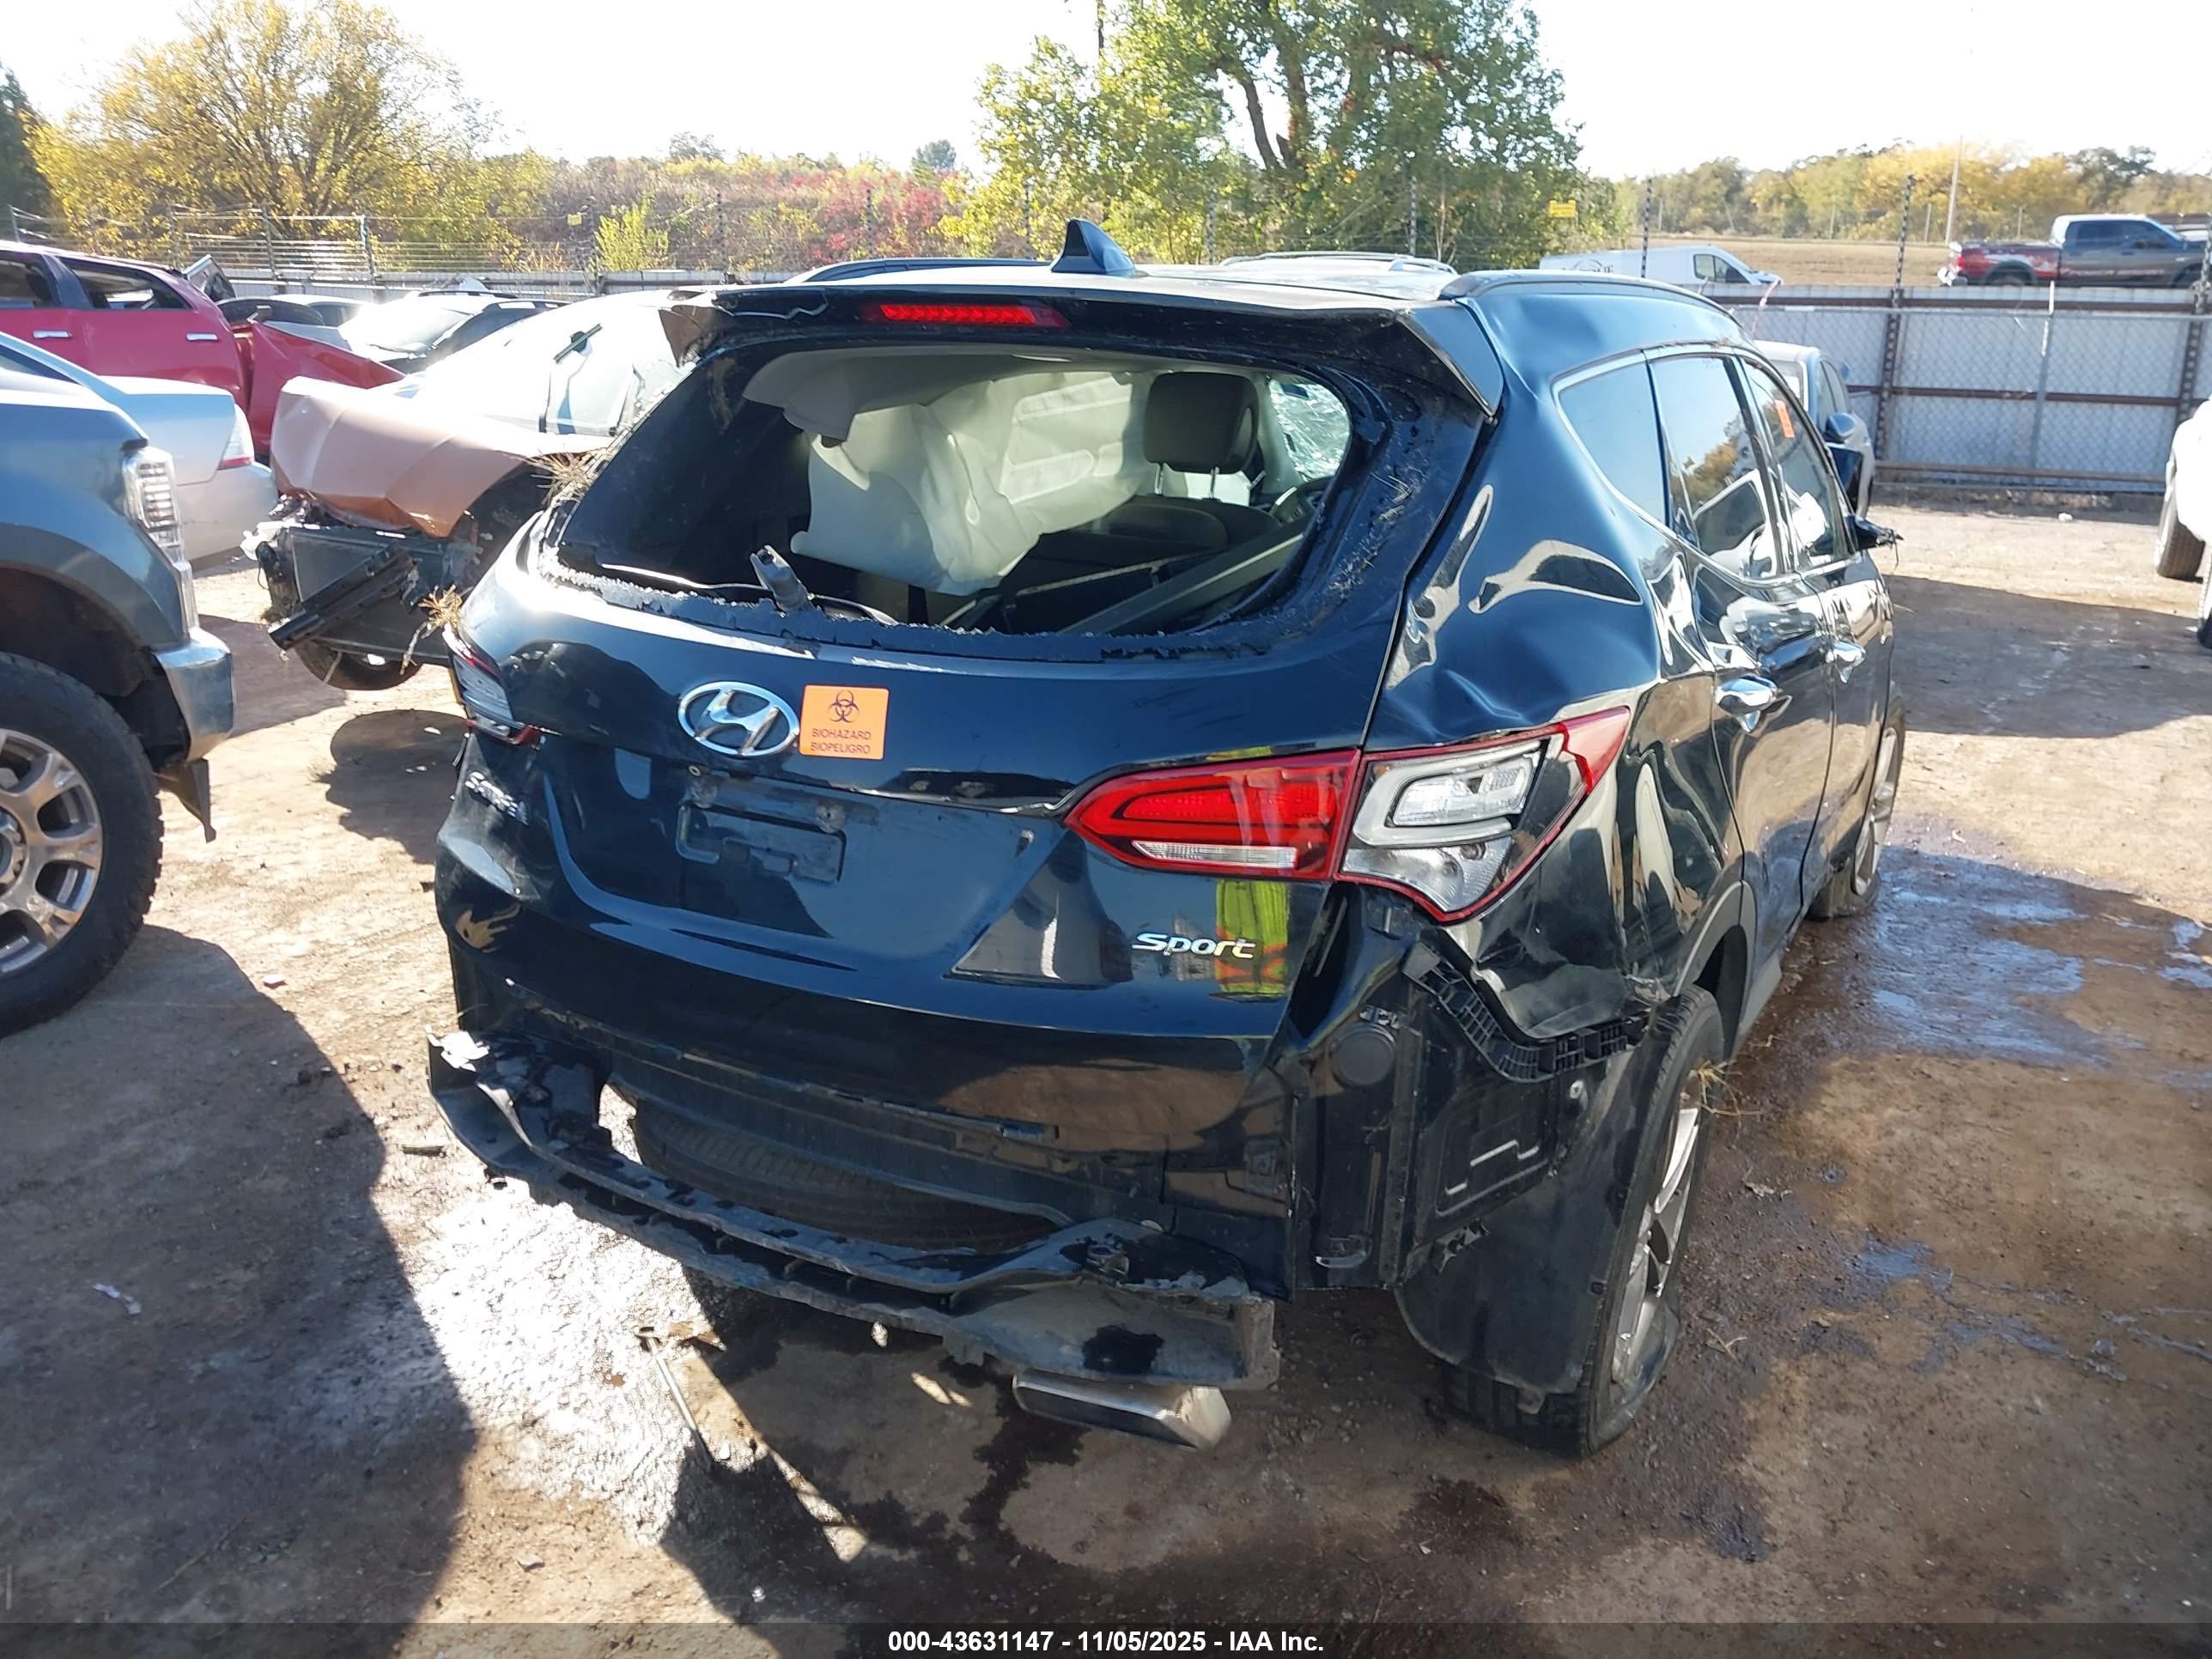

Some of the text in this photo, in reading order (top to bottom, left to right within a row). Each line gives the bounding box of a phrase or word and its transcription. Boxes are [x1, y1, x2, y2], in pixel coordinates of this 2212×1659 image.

[811, 727, 872, 740] BIOHAZARD
[811, 741, 871, 755] BIOPELIGRO
[1131, 933, 1256, 959] Sport
